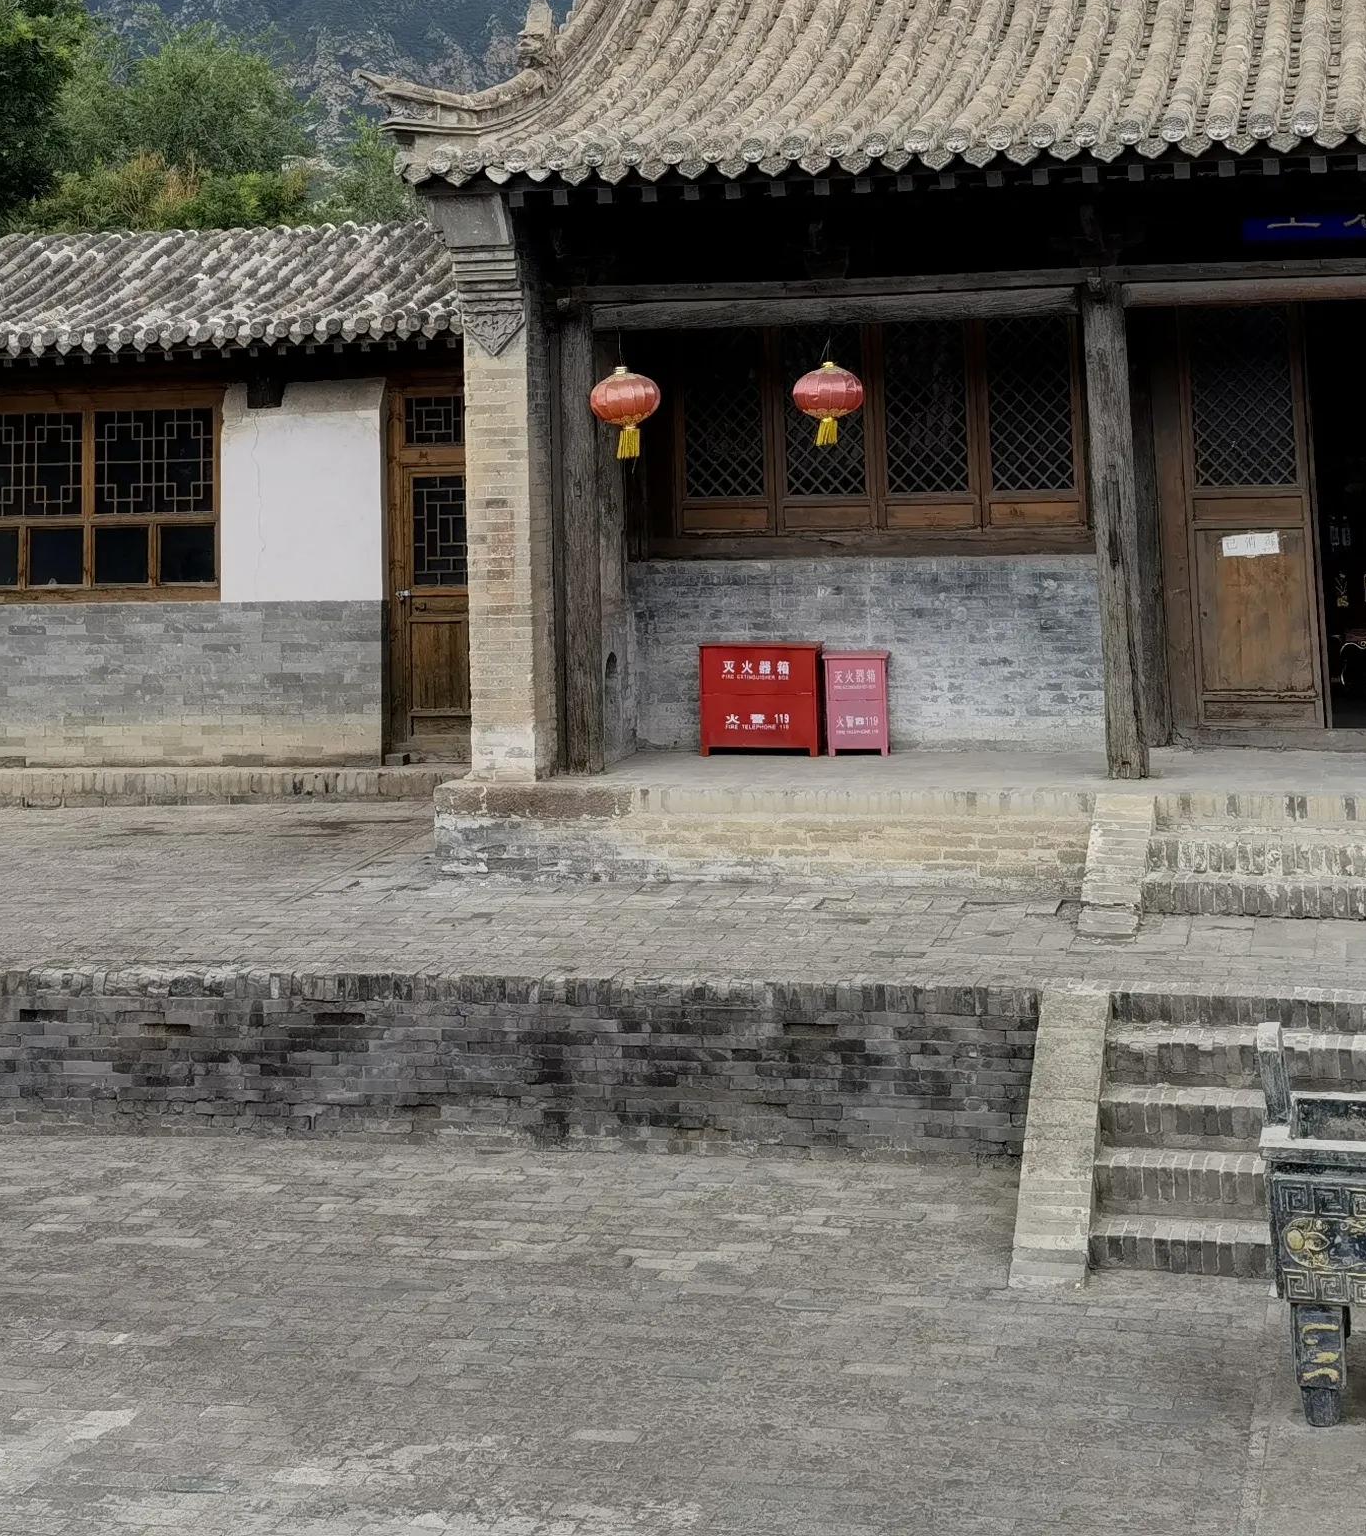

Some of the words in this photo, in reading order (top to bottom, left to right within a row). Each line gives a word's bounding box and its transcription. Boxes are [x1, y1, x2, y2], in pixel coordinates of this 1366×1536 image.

[722, 660, 790, 674] 灭火器箱
[834, 668, 876, 683] 灭火器箱
